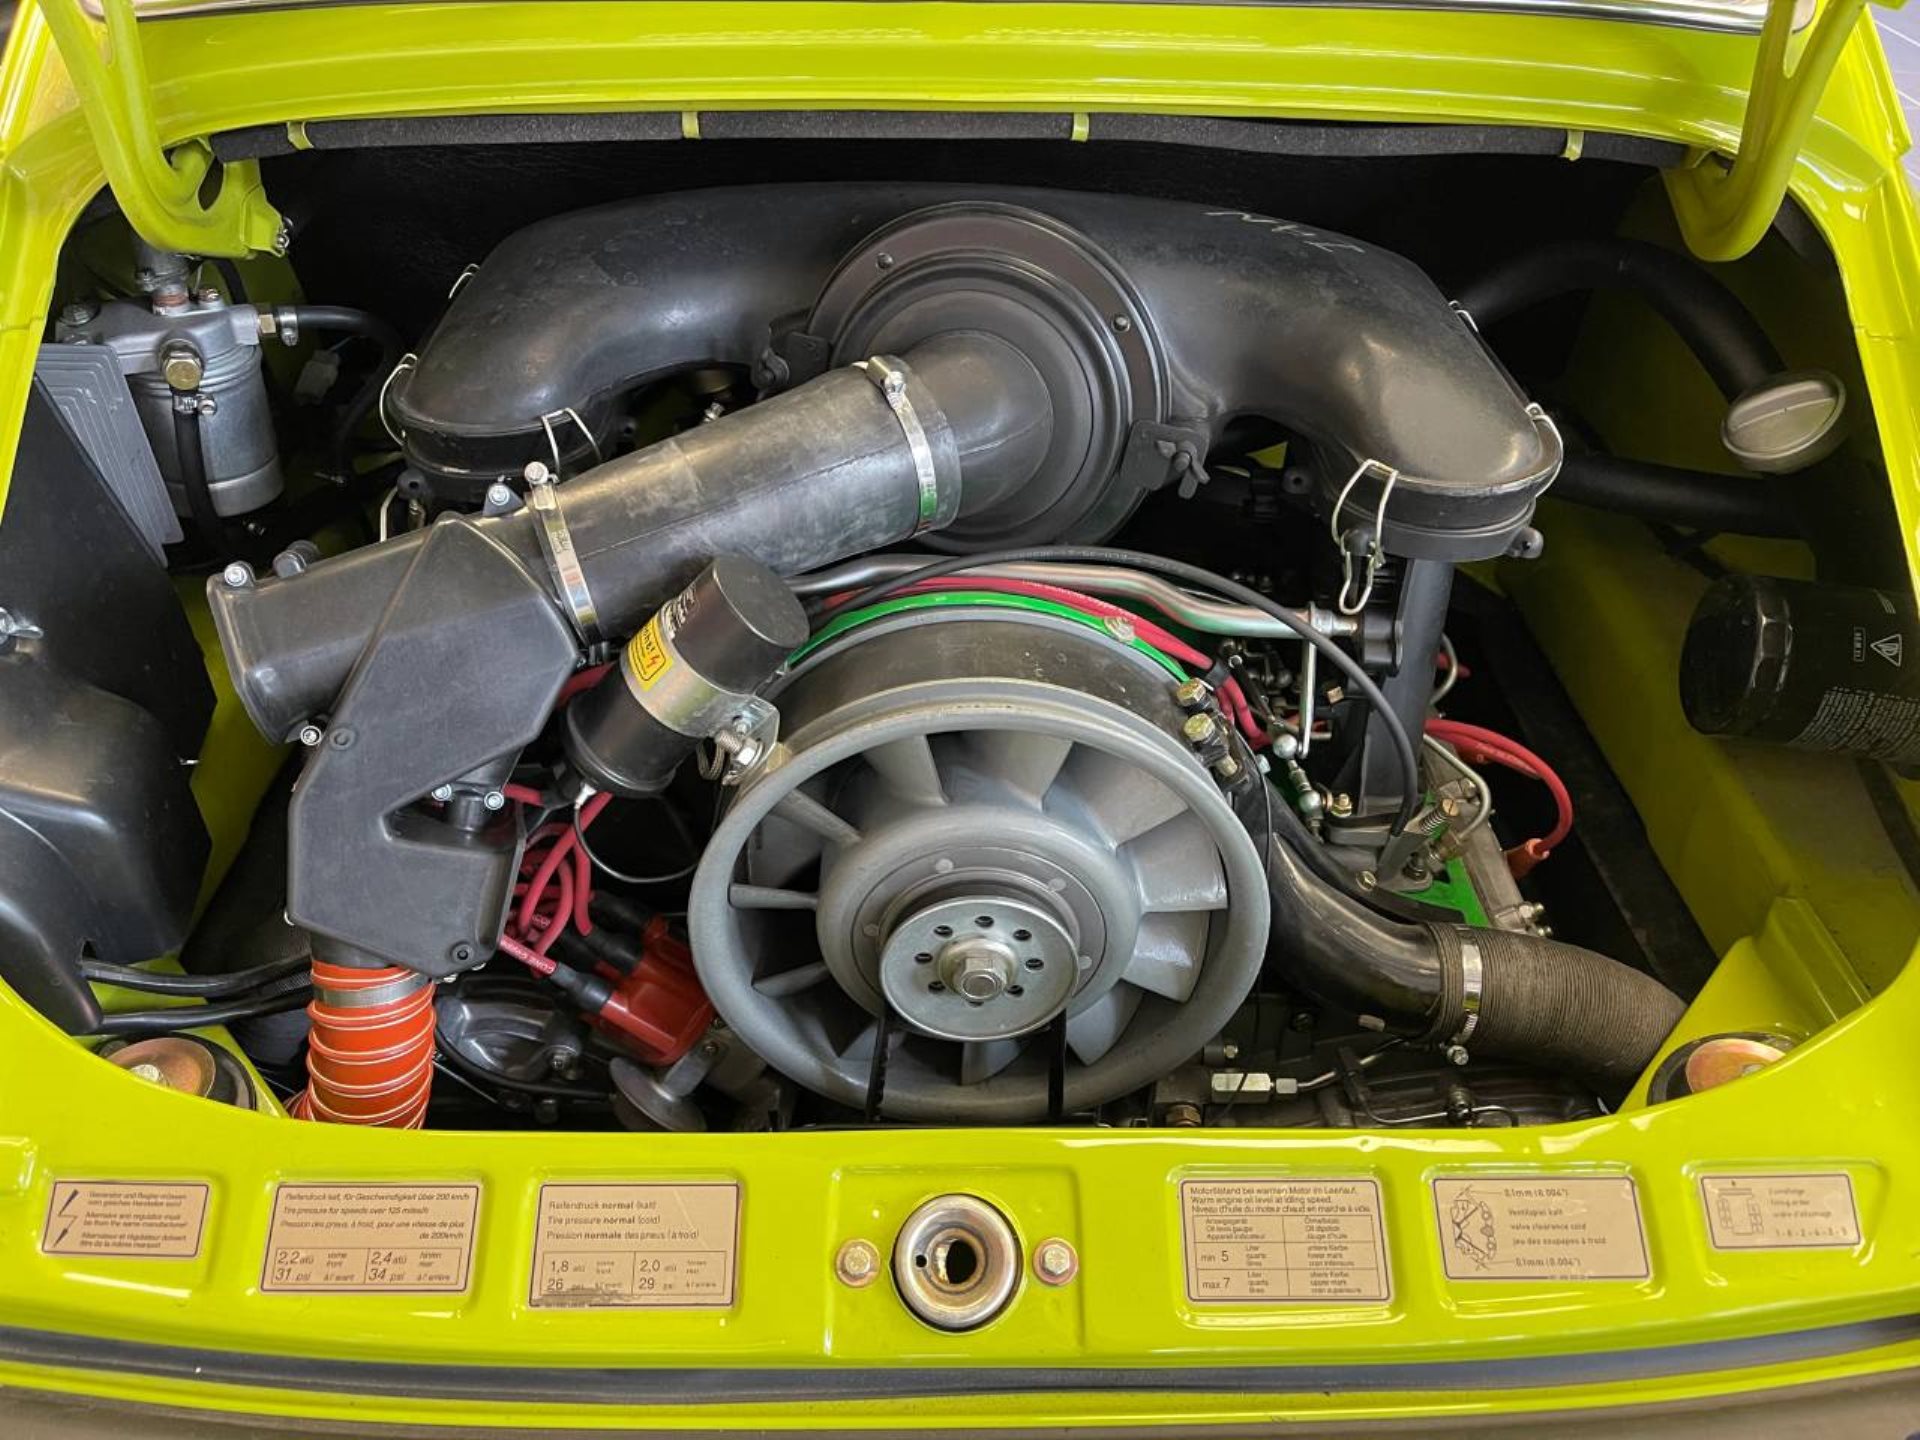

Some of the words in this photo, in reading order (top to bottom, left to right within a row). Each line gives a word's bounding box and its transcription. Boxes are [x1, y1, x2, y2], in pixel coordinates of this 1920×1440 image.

[602, 1201, 635, 1210] normal
[603, 1216, 635, 1224] normal
[584, 1231, 622, 1240] normale
[278, 1251, 300, 1266] 2,2
[371, 1251, 393, 1266] 2,4
[1201, 1253, 1216, 1262] min
[552, 1260, 569, 1273] 1,8
[639, 1259, 661, 1273] 2,0
[275, 1268, 292, 1281] 31
[295, 1272, 312, 1283] psi
[368, 1268, 387, 1281] 34
[389, 1273, 405, 1283] psi
[547, 1278, 564, 1290] 26
[638, 1277, 655, 1290] 29
[1202, 1281, 1220, 1289] max
